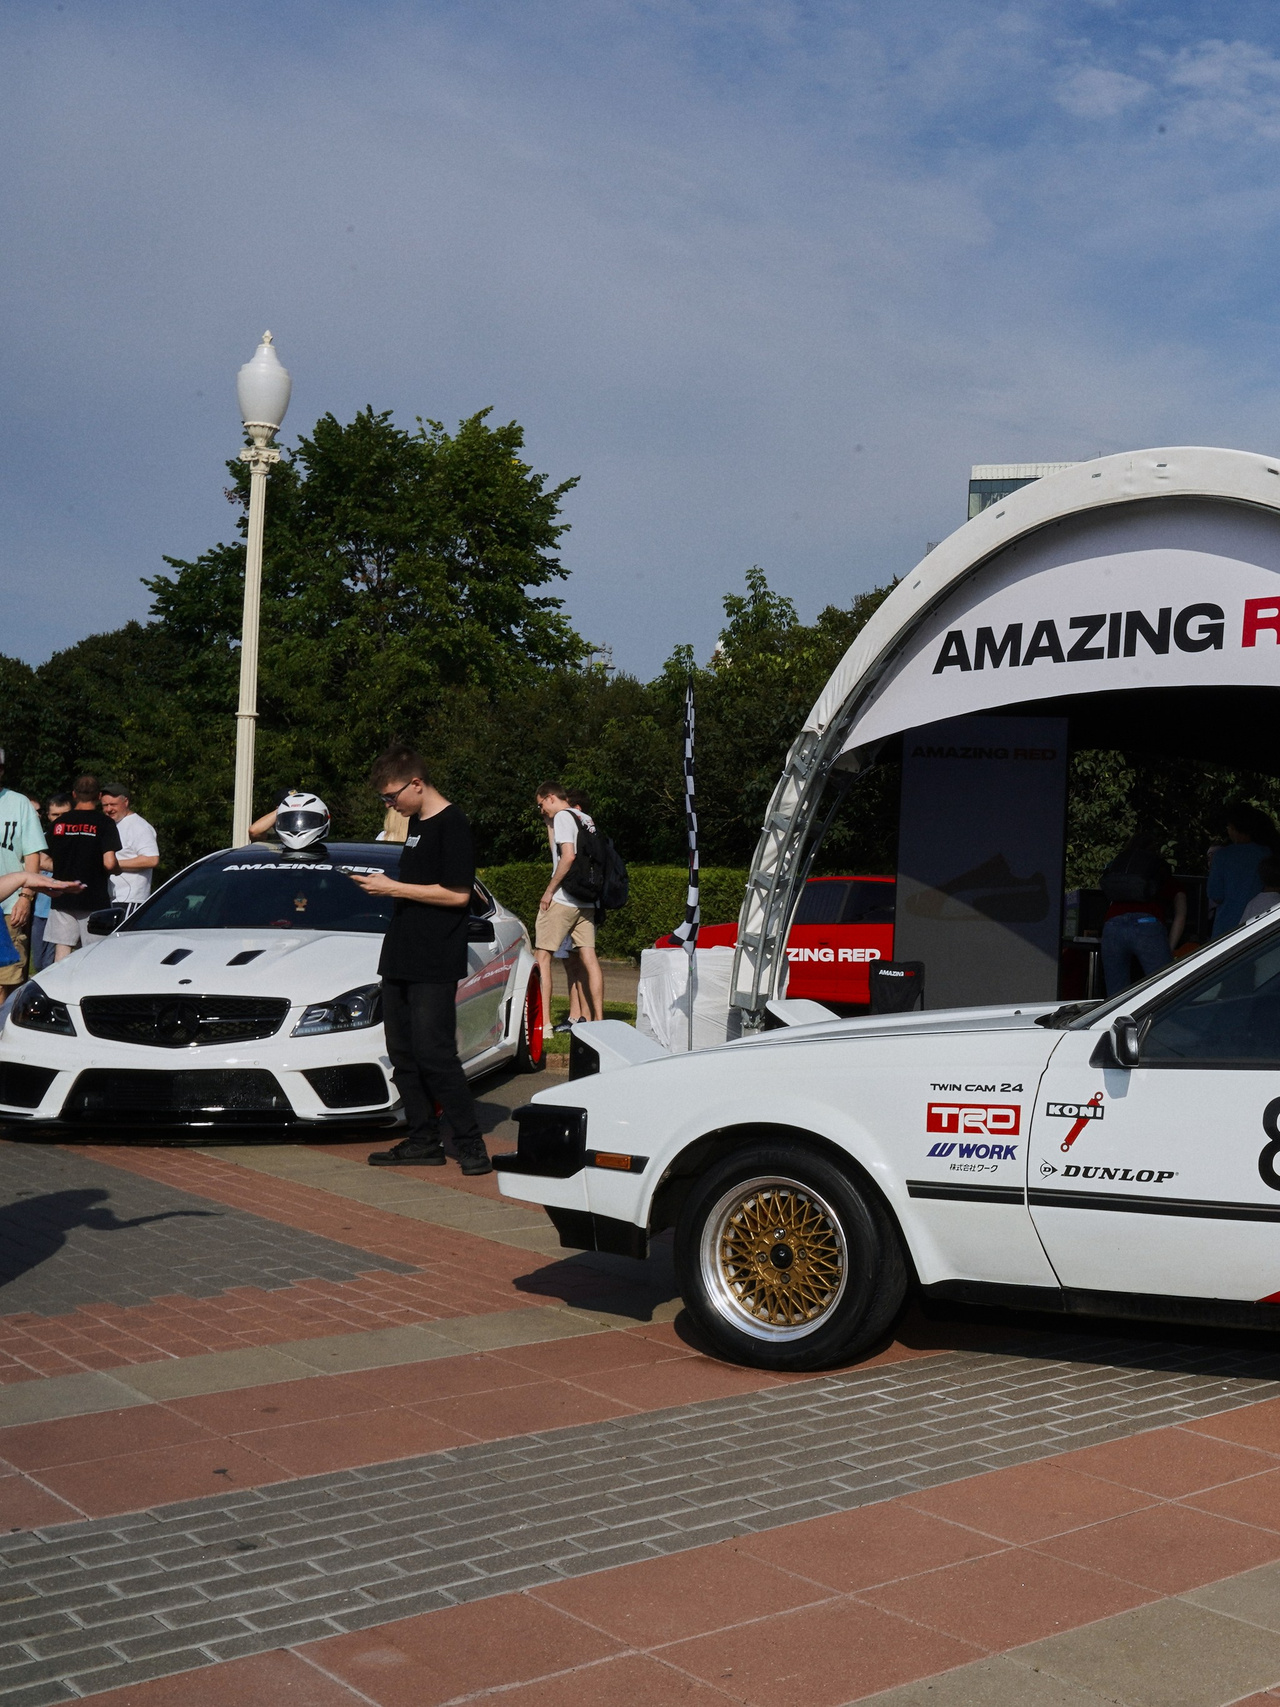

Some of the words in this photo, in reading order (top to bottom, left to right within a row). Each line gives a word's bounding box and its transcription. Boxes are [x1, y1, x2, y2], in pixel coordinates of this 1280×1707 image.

[932, 603, 1225, 674] AMAZING
[911, 746, 1009, 759] AMAZING
[1014, 748, 1056, 760] RED
[222, 863, 333, 872] AMAZING
[786, 948, 835, 962] ZING
[838, 948, 881, 962] RED
[930, 1083, 961, 1092] TWIN
[965, 1084, 996, 1092] CAM
[1000, 1083, 1024, 1093] 24
[1048, 1104, 1102, 1117] KONI
[931, 1107, 1016, 1134] TRD
[958, 1143, 1019, 1160] WORK
[949, 1163, 998, 1173] 株式会社ワーク
[1061, 1164, 1174, 1183] DUNLOP
